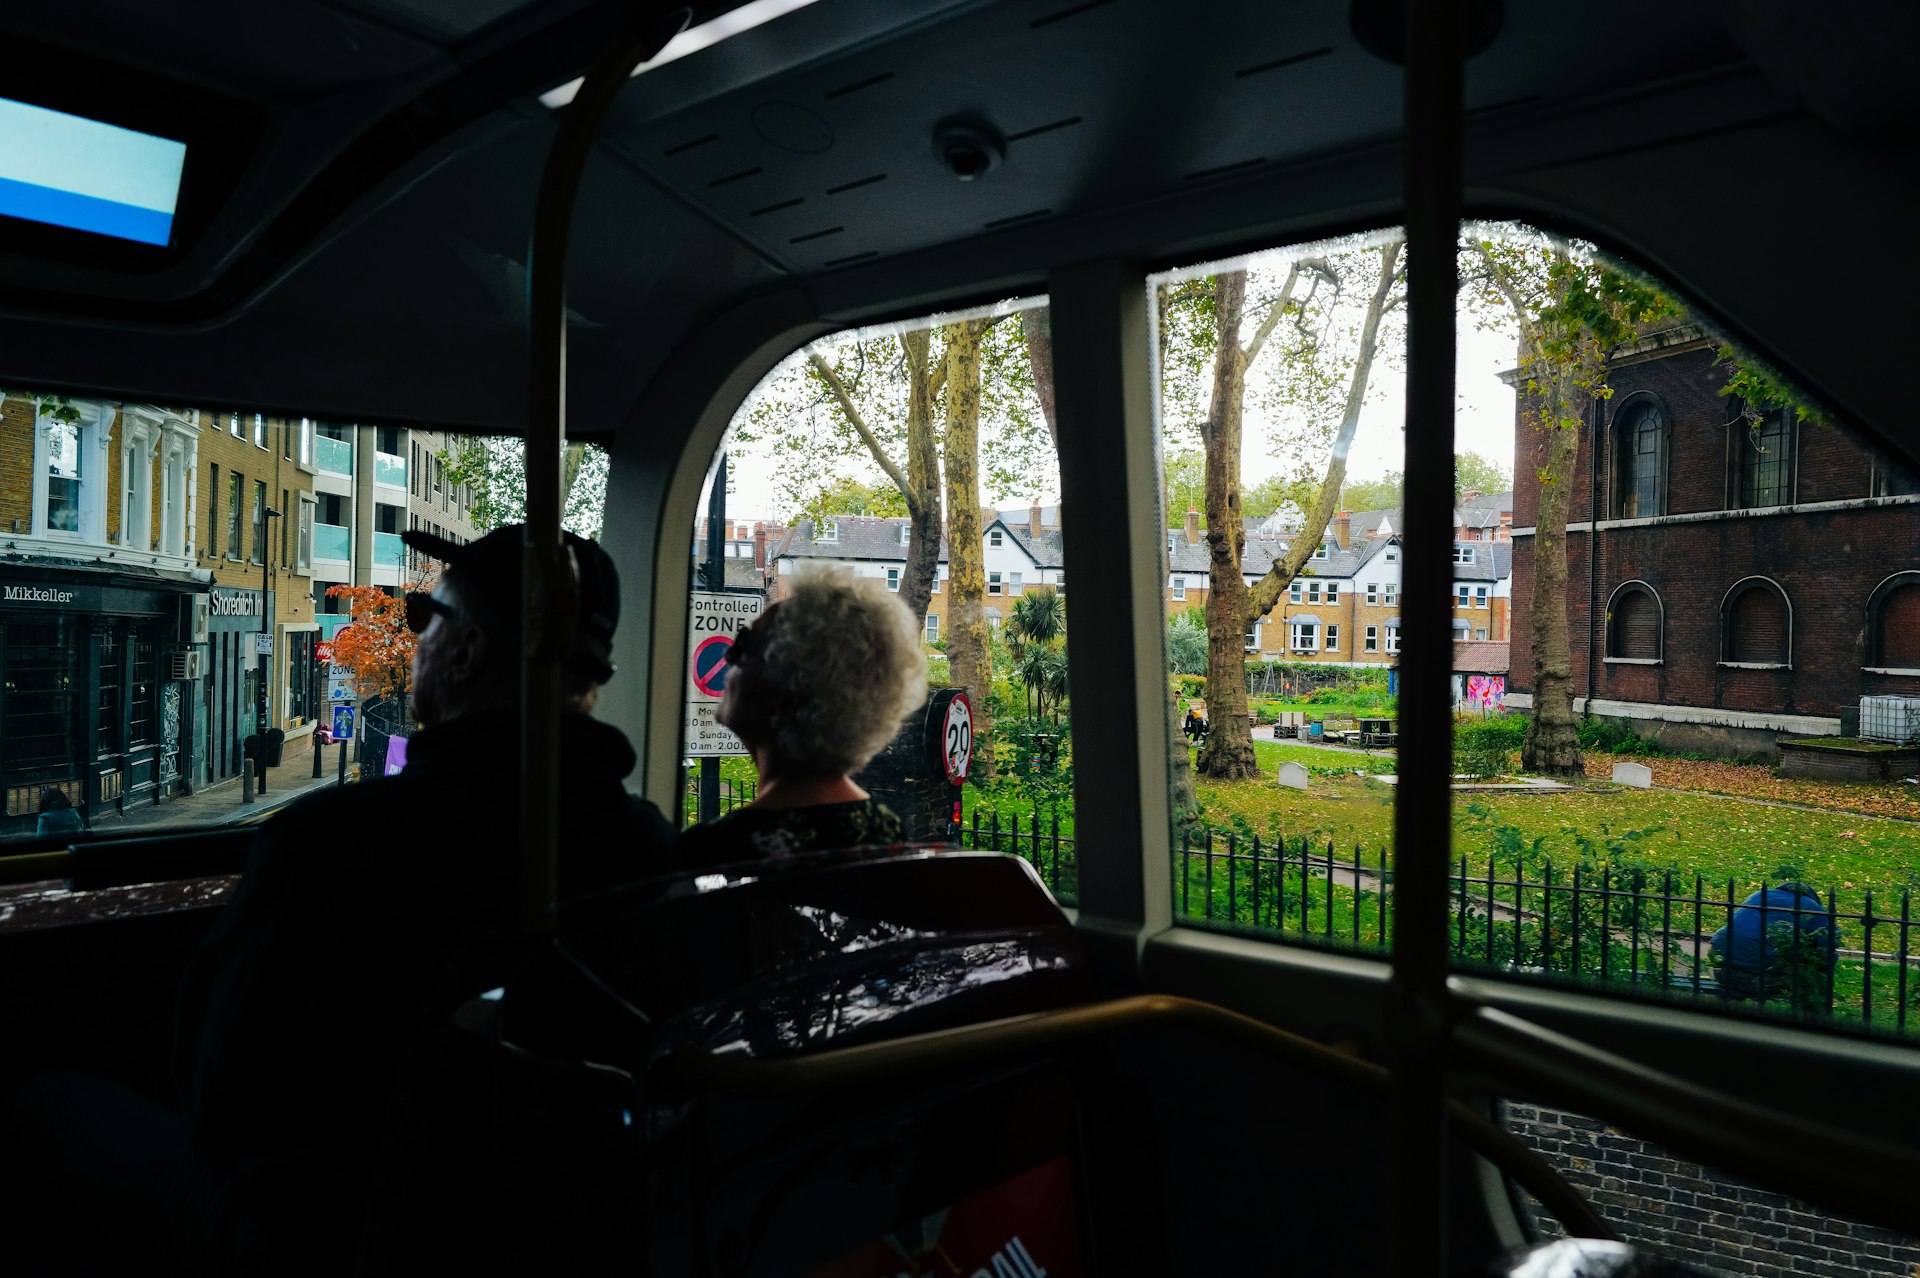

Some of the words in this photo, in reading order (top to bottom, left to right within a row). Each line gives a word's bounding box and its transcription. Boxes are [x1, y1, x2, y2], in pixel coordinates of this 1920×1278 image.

[4, 586, 73, 602] Mikkeller
[212, 589, 254, 616] Shoreditch
[255, 593, 263, 616] In
[695, 615, 746, 632] ZONE
[699, 731, 733, 740] Sunday
[948, 721, 970, 759] 20
